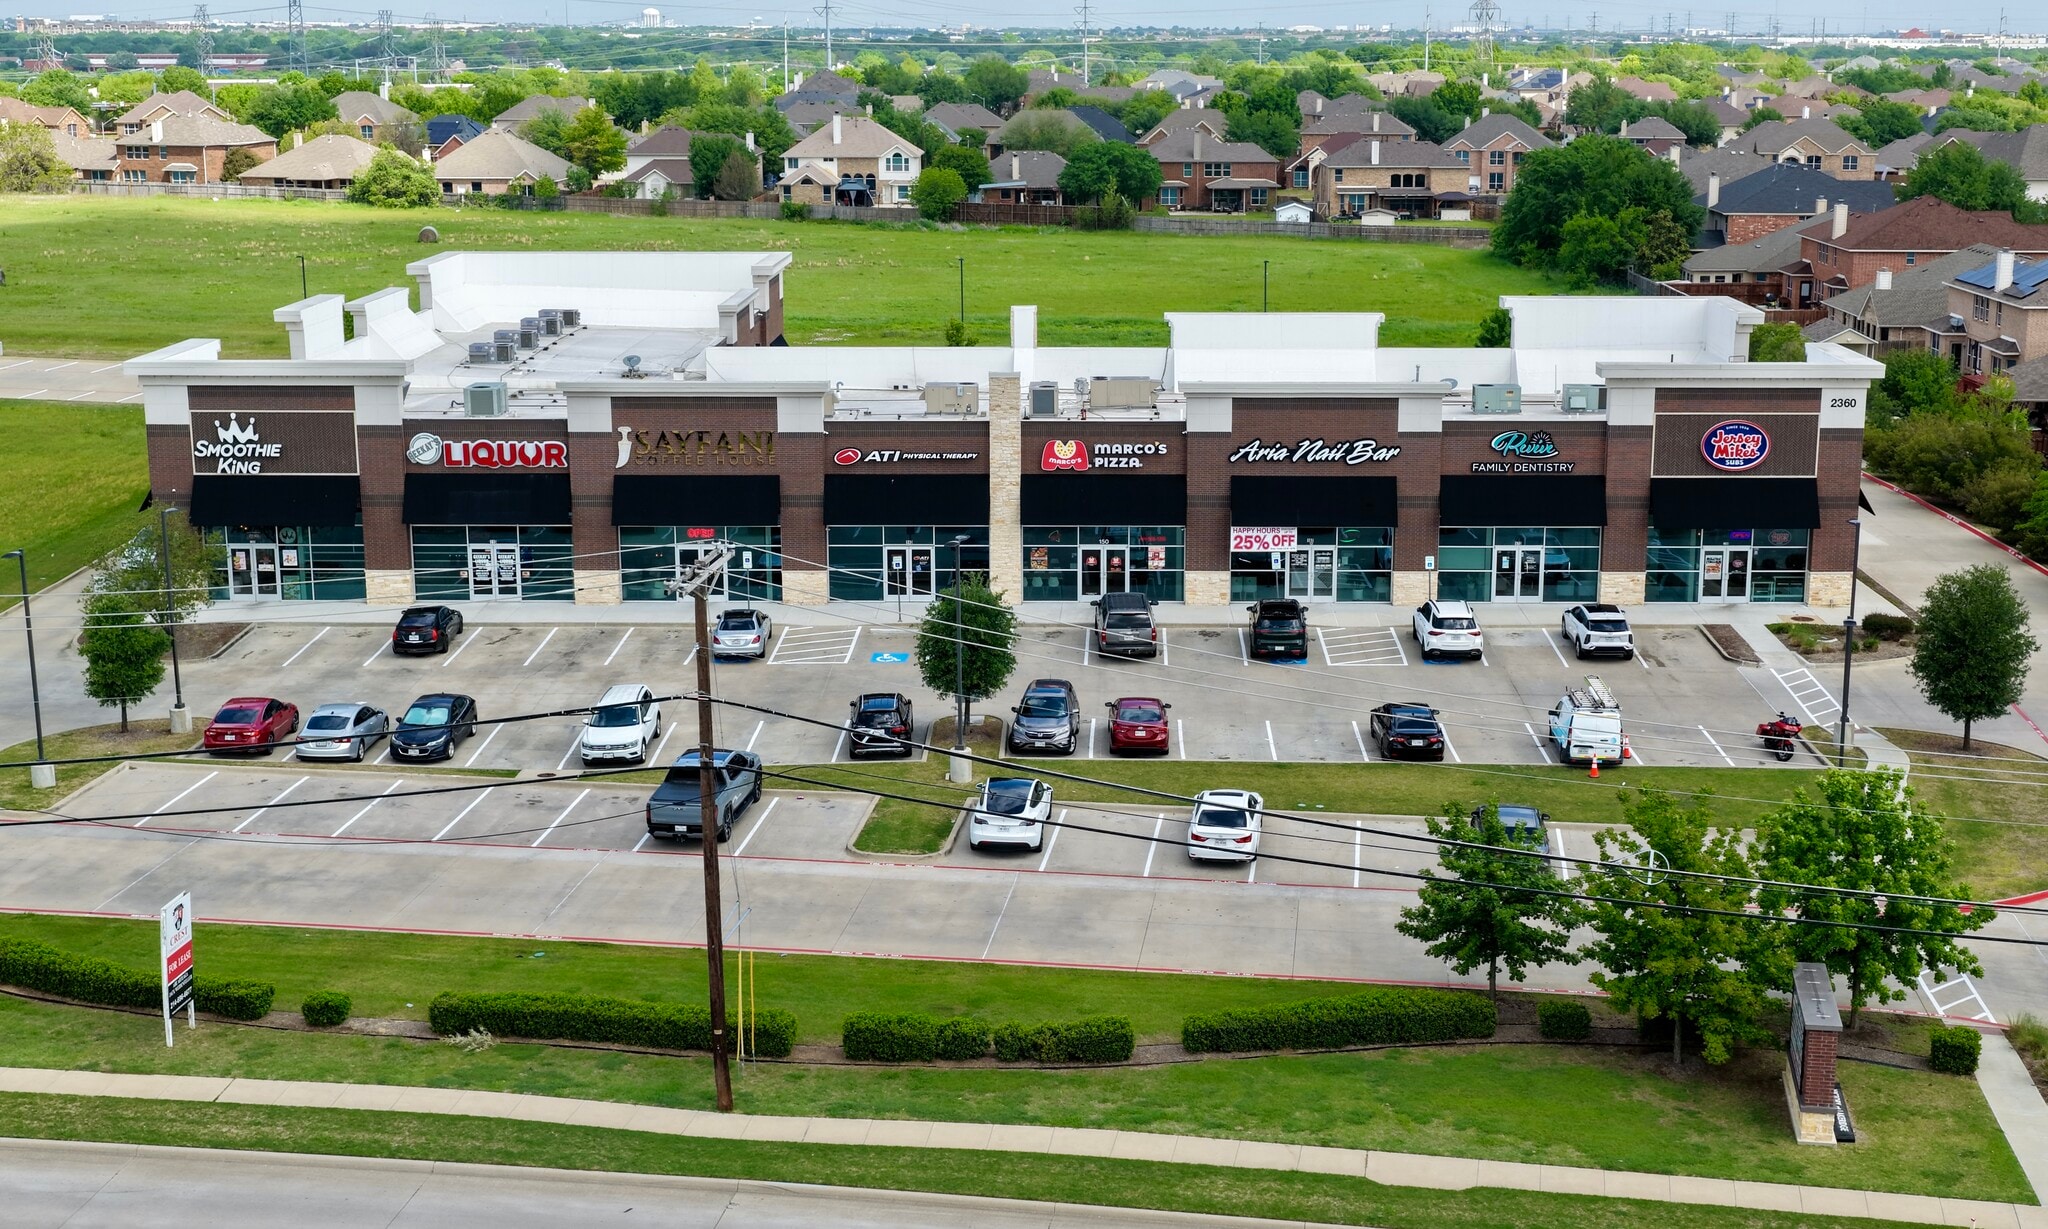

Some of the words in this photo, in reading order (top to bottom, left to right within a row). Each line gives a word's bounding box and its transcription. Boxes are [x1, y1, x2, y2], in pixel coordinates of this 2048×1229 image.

[1830, 398, 1857, 408] 2360
[635, 430, 775, 455] SAYFANI
[1491, 431, 1556, 457] Revive
[1712, 430, 1761, 446] Jersey
[194, 440, 282, 457] SMOOTHIE
[444, 442, 566, 467] LIQUOR
[1094, 442, 1167, 454] MARCO'S
[1230, 440, 1290, 462] Aria
[1292, 440, 1350, 462] Nail
[1346, 439, 1400, 465] Bar
[1714, 444, 1758, 458] Mike's
[635, 455, 704, 465] COFFEE
[716, 455, 776, 465] HOUSE
[864, 451, 900, 462] ATI
[1049, 457, 1082, 465] MARCO'S
[1094, 457, 1139, 468] PIZZA
[1472, 463, 1511, 472] FAMILY
[1514, 463, 1574, 472] DENTISTRY
[687, 528, 715, 538] OPEN
[1233, 534, 1270, 550] 25%
[1272, 534, 1295, 546] OFF
[170, 926, 188, 946] CREST
[168, 960, 178, 974] FOR
[178, 949, 192, 966] LEASE
